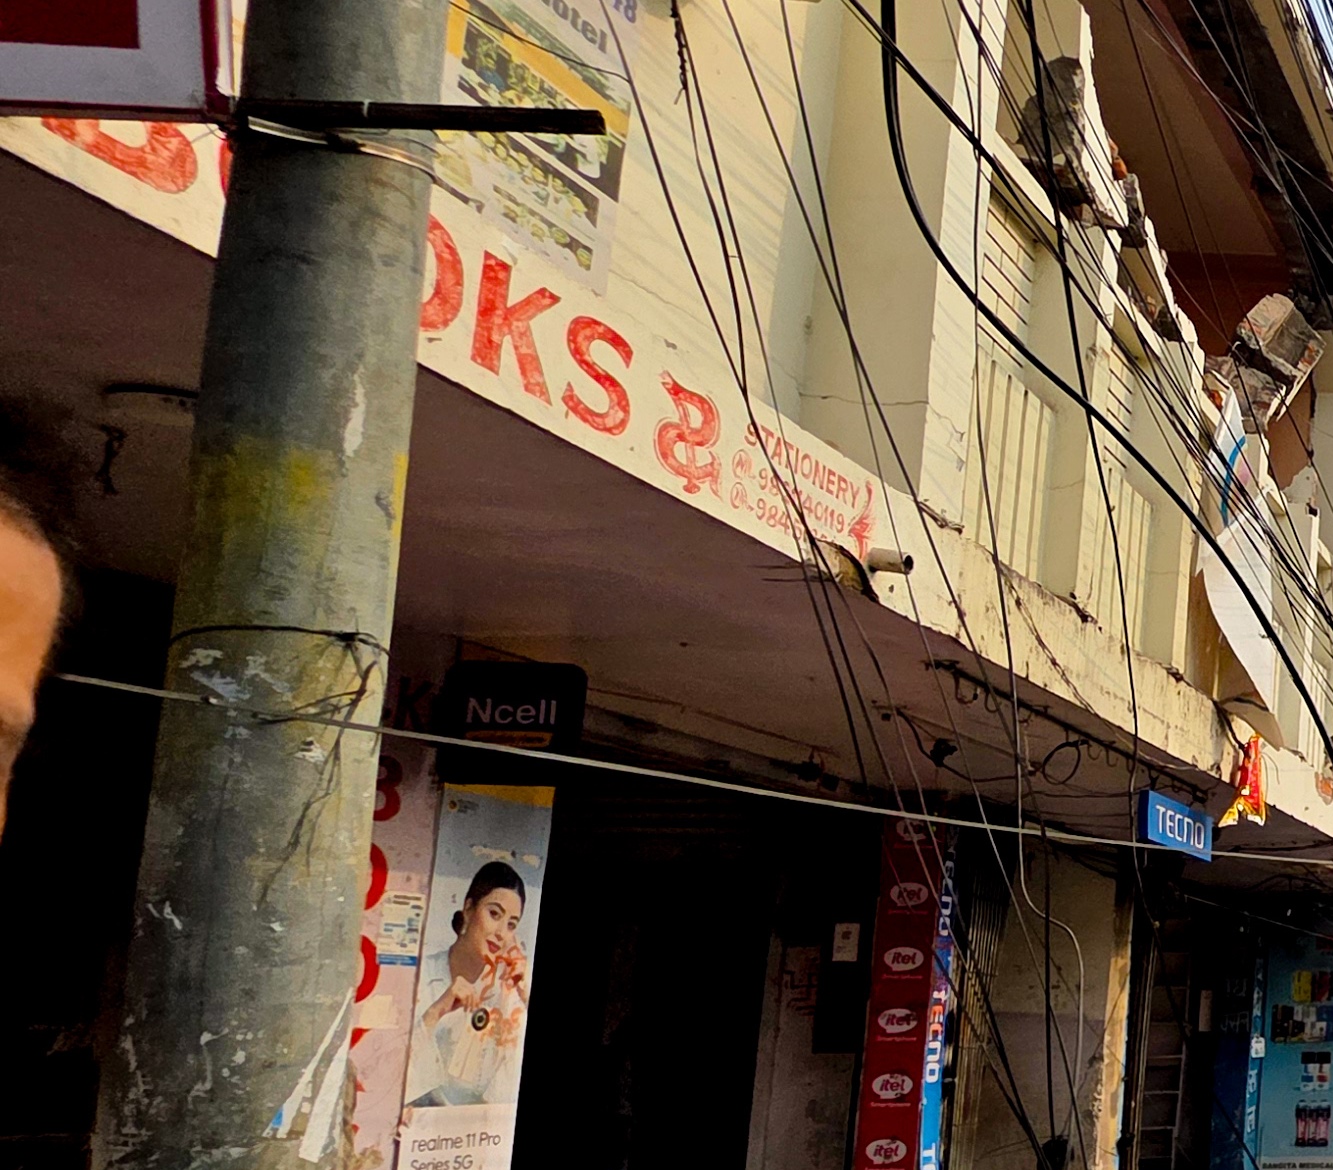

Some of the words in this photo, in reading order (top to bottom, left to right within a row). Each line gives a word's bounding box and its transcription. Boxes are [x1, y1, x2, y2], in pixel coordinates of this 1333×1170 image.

[541, 0, 608, 54] otel
[744, 421, 861, 510] STATIONERY
[466, 697, 557, 725] Ncell
[1156, 804, 1205, 849] TECNO
[891, 950, 918, 964] itel
[885, 1012, 913, 1026] itel
[925, 990, 947, 1083] TECNO
[879, 1078, 906, 1092] itel
[411, 1135, 463, 1153] realme
[466, 1133, 476, 1148] 11
[479, 1131, 501, 1147] Pro
[873, 1144, 900, 1158] itel
[452, 1154, 474, 1170] 5G
